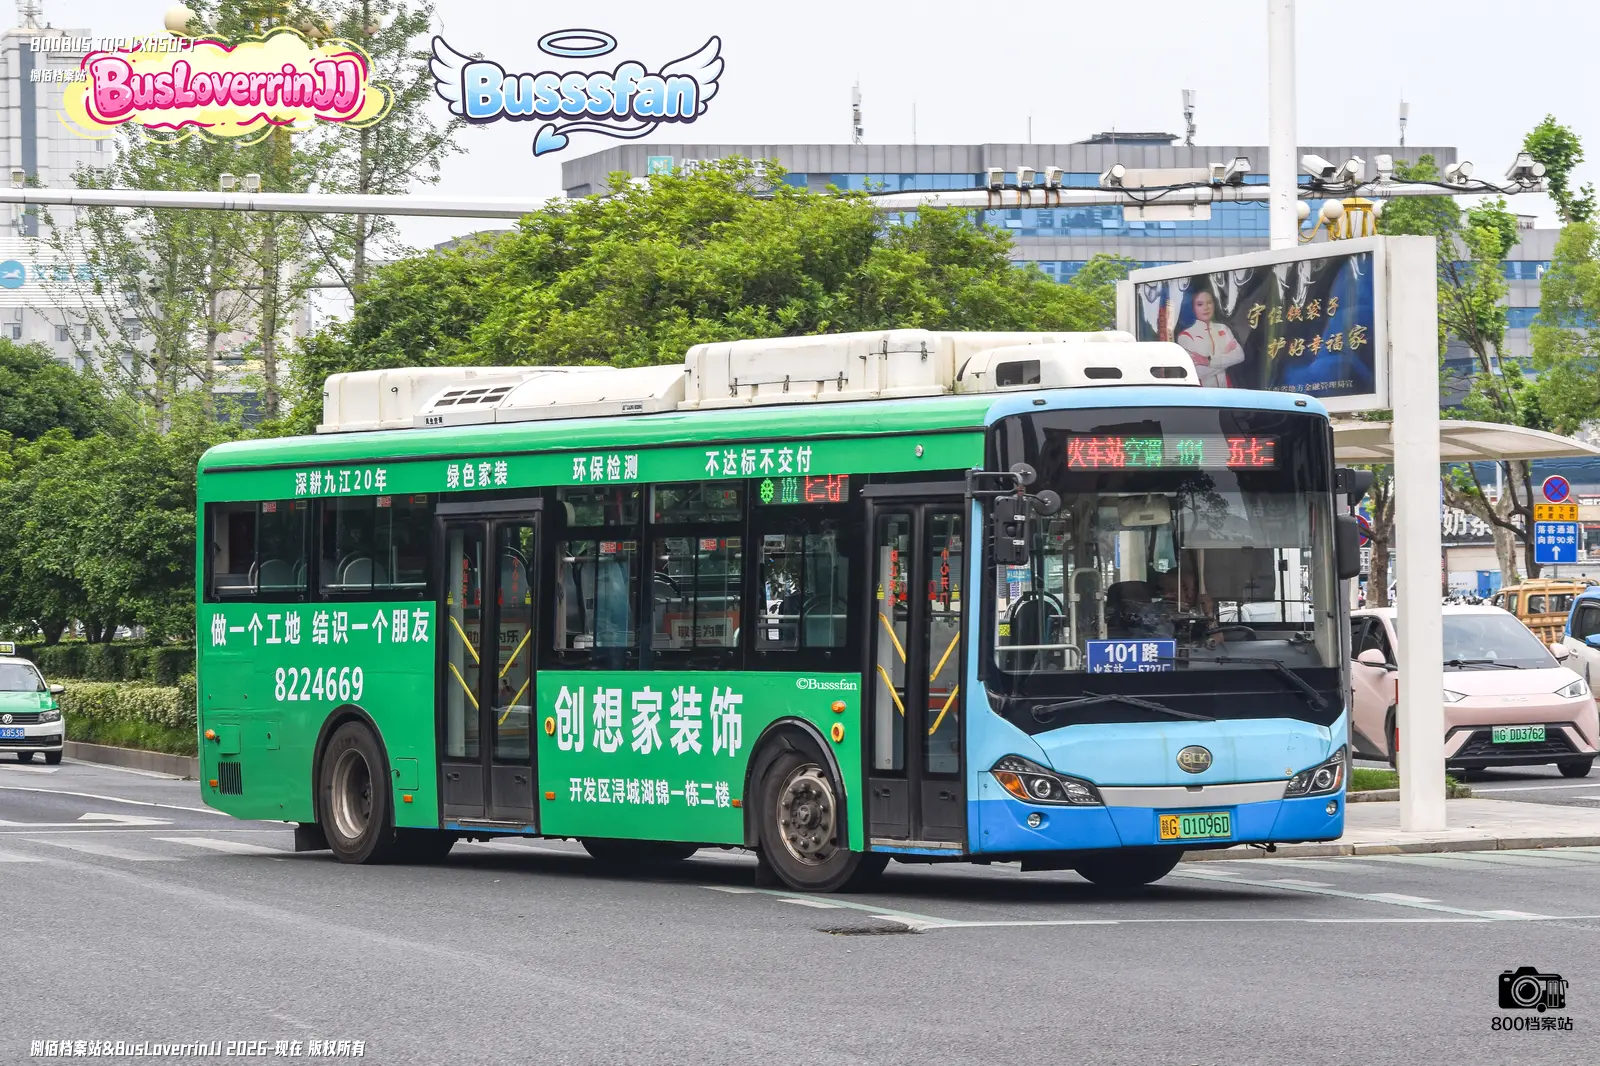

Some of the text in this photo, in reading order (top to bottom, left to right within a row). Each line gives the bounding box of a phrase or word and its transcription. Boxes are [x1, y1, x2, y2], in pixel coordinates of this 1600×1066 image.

[1247, 296, 1340, 330] 守住钱袋子
[1267, 324, 1368, 360] 护好幸福家
[447, 461, 507, 488] 绿色家装
[572, 454, 638, 481] 环保检测
[705, 446, 812, 476] 不达标不交付
[295, 468, 387, 495] 深耕九江20年
[1537, 525, 1576, 534] 落客通道
[1537, 536, 1576, 545] 向前90米
[211, 608, 429, 647] 做一个工地 结识一个朋友
[274, 666, 364, 702] 8224669
[554, 685, 743, 757] 创想家装饰
[569, 777, 730, 808] 开发区浔城湖锦一栋二楼
